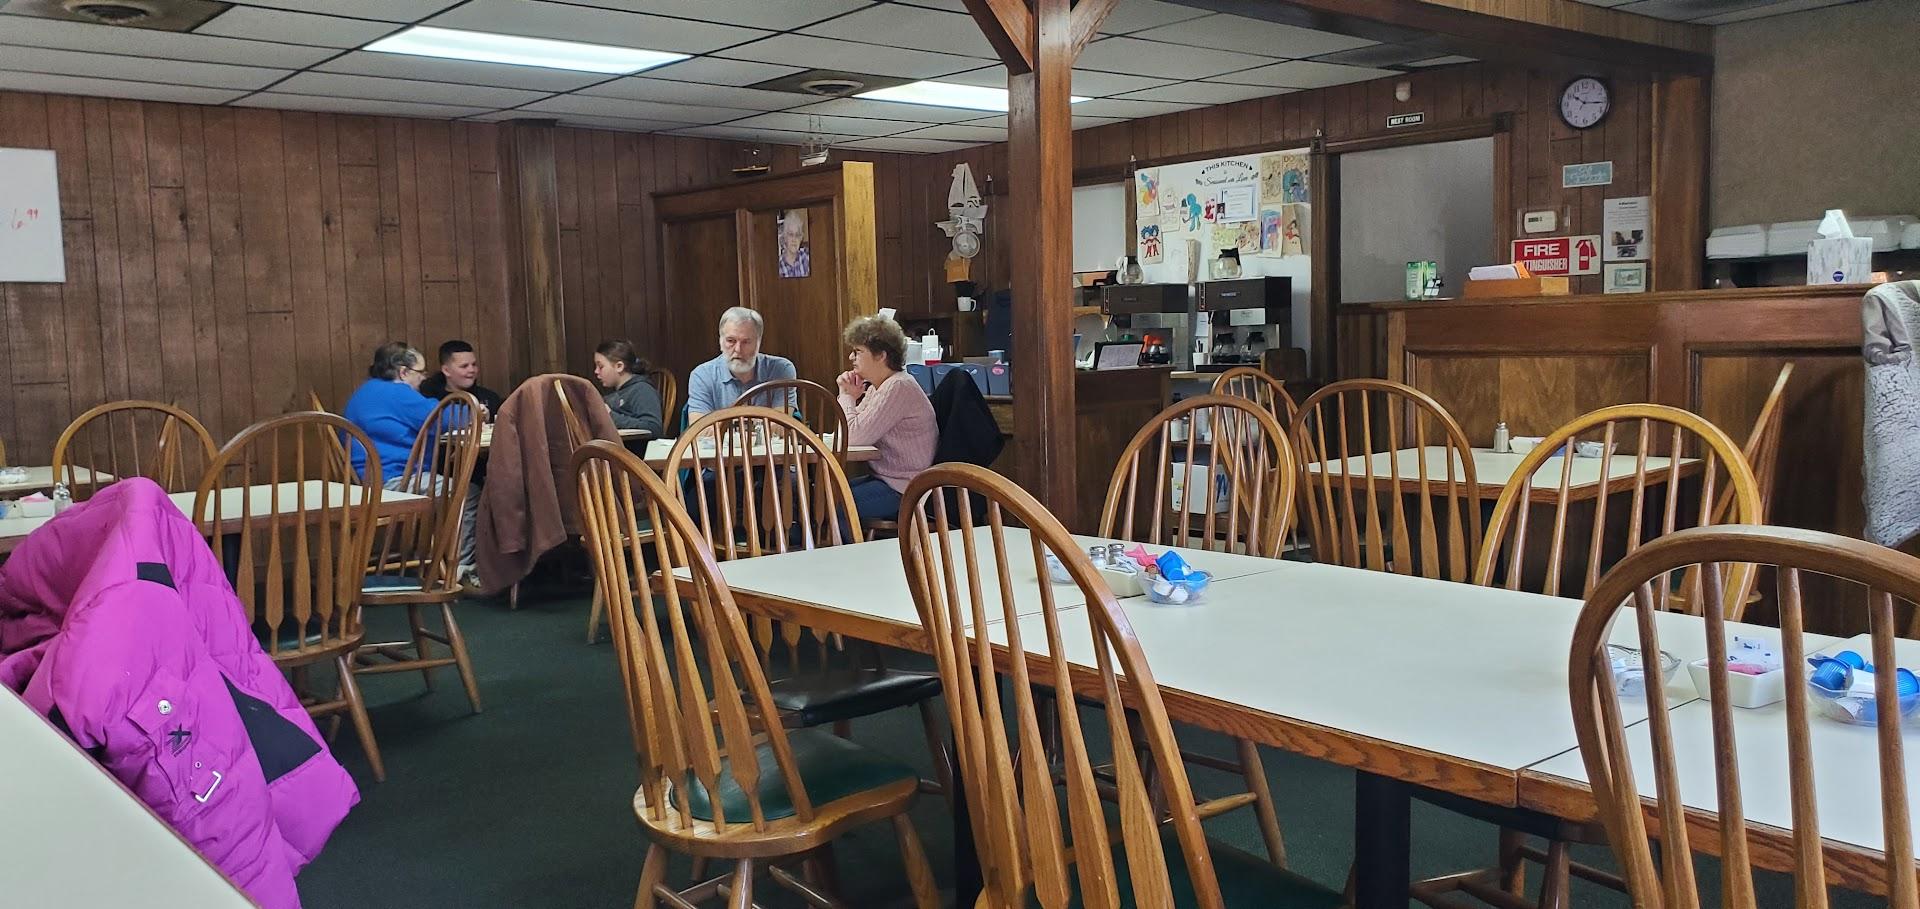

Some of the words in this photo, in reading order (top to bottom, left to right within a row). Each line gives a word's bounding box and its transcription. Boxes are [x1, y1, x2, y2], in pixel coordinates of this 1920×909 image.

[1581, 81, 1589, 89] 12
[1405, 115, 1420, 123] ROOM
[1205, 162, 1219, 170] THIS
[1221, 160, 1248, 168] KITCHEN
[1523, 243, 1560, 257] FIRE
[1524, 258, 1568, 271] TINGUISHER
